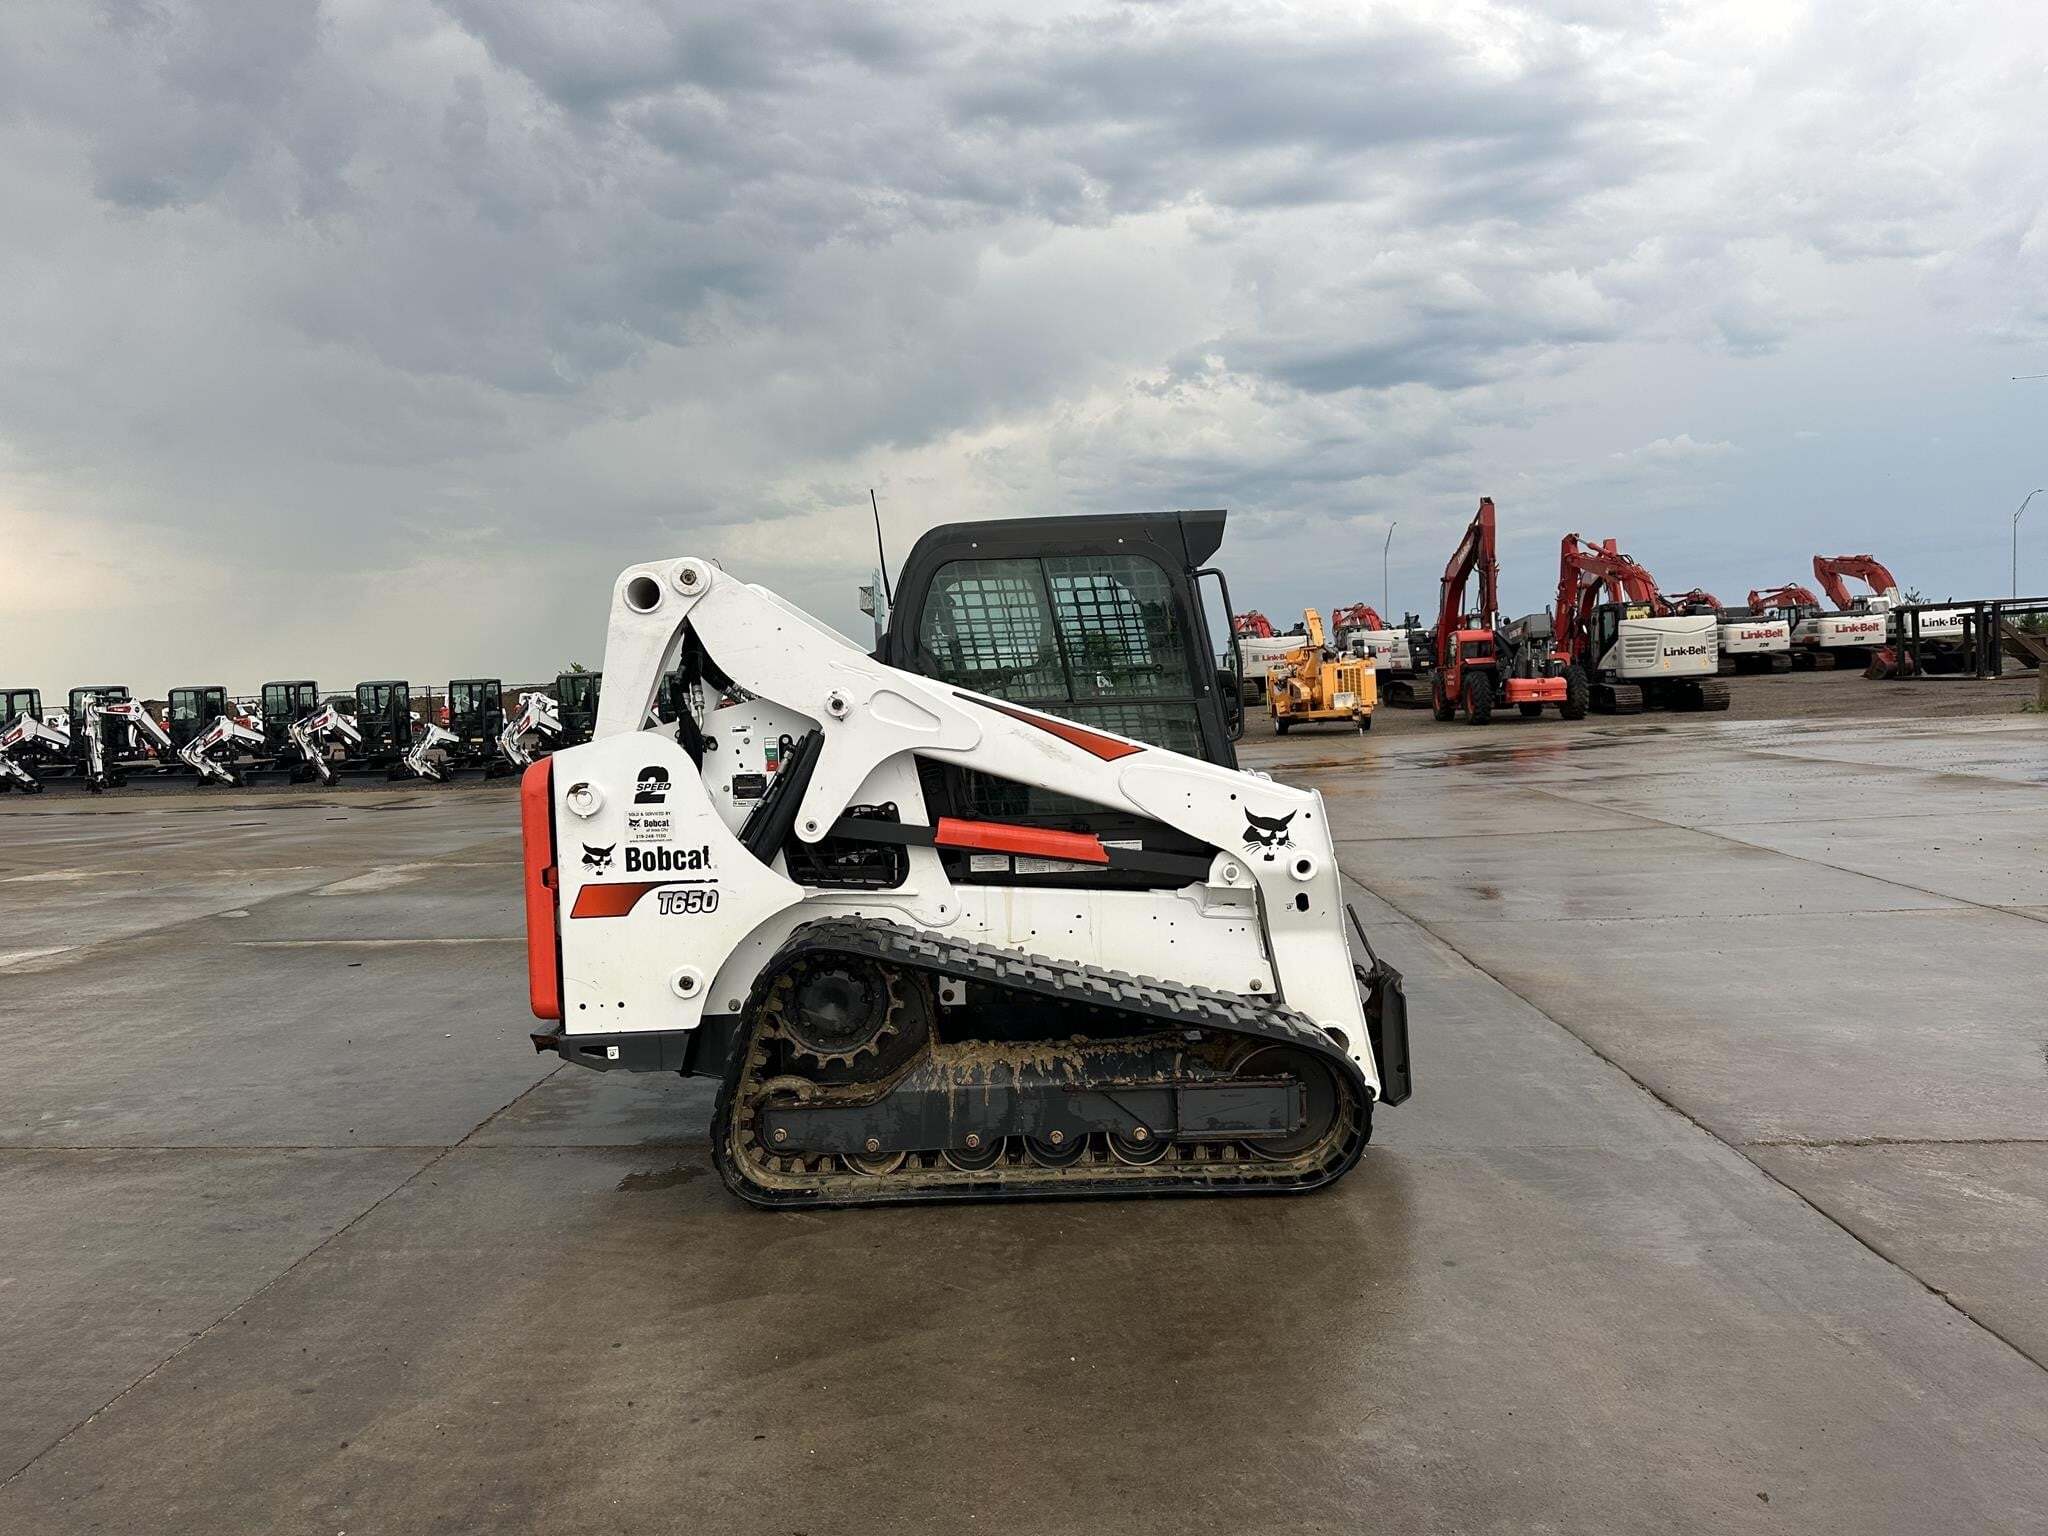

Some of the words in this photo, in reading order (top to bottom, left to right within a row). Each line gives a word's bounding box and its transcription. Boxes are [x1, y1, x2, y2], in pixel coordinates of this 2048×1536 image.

[1834, 622, 1880, 634] Link-Belt
[1740, 628, 1784, 641] Link-Belt
[1663, 645, 1707, 657] Link-Belt
[634, 765, 669, 804] 2
[636, 782, 672, 792] SPEED
[643, 818, 670, 828] Bobcat
[625, 845, 712, 872] Bobcat
[658, 889, 719, 915] T650
